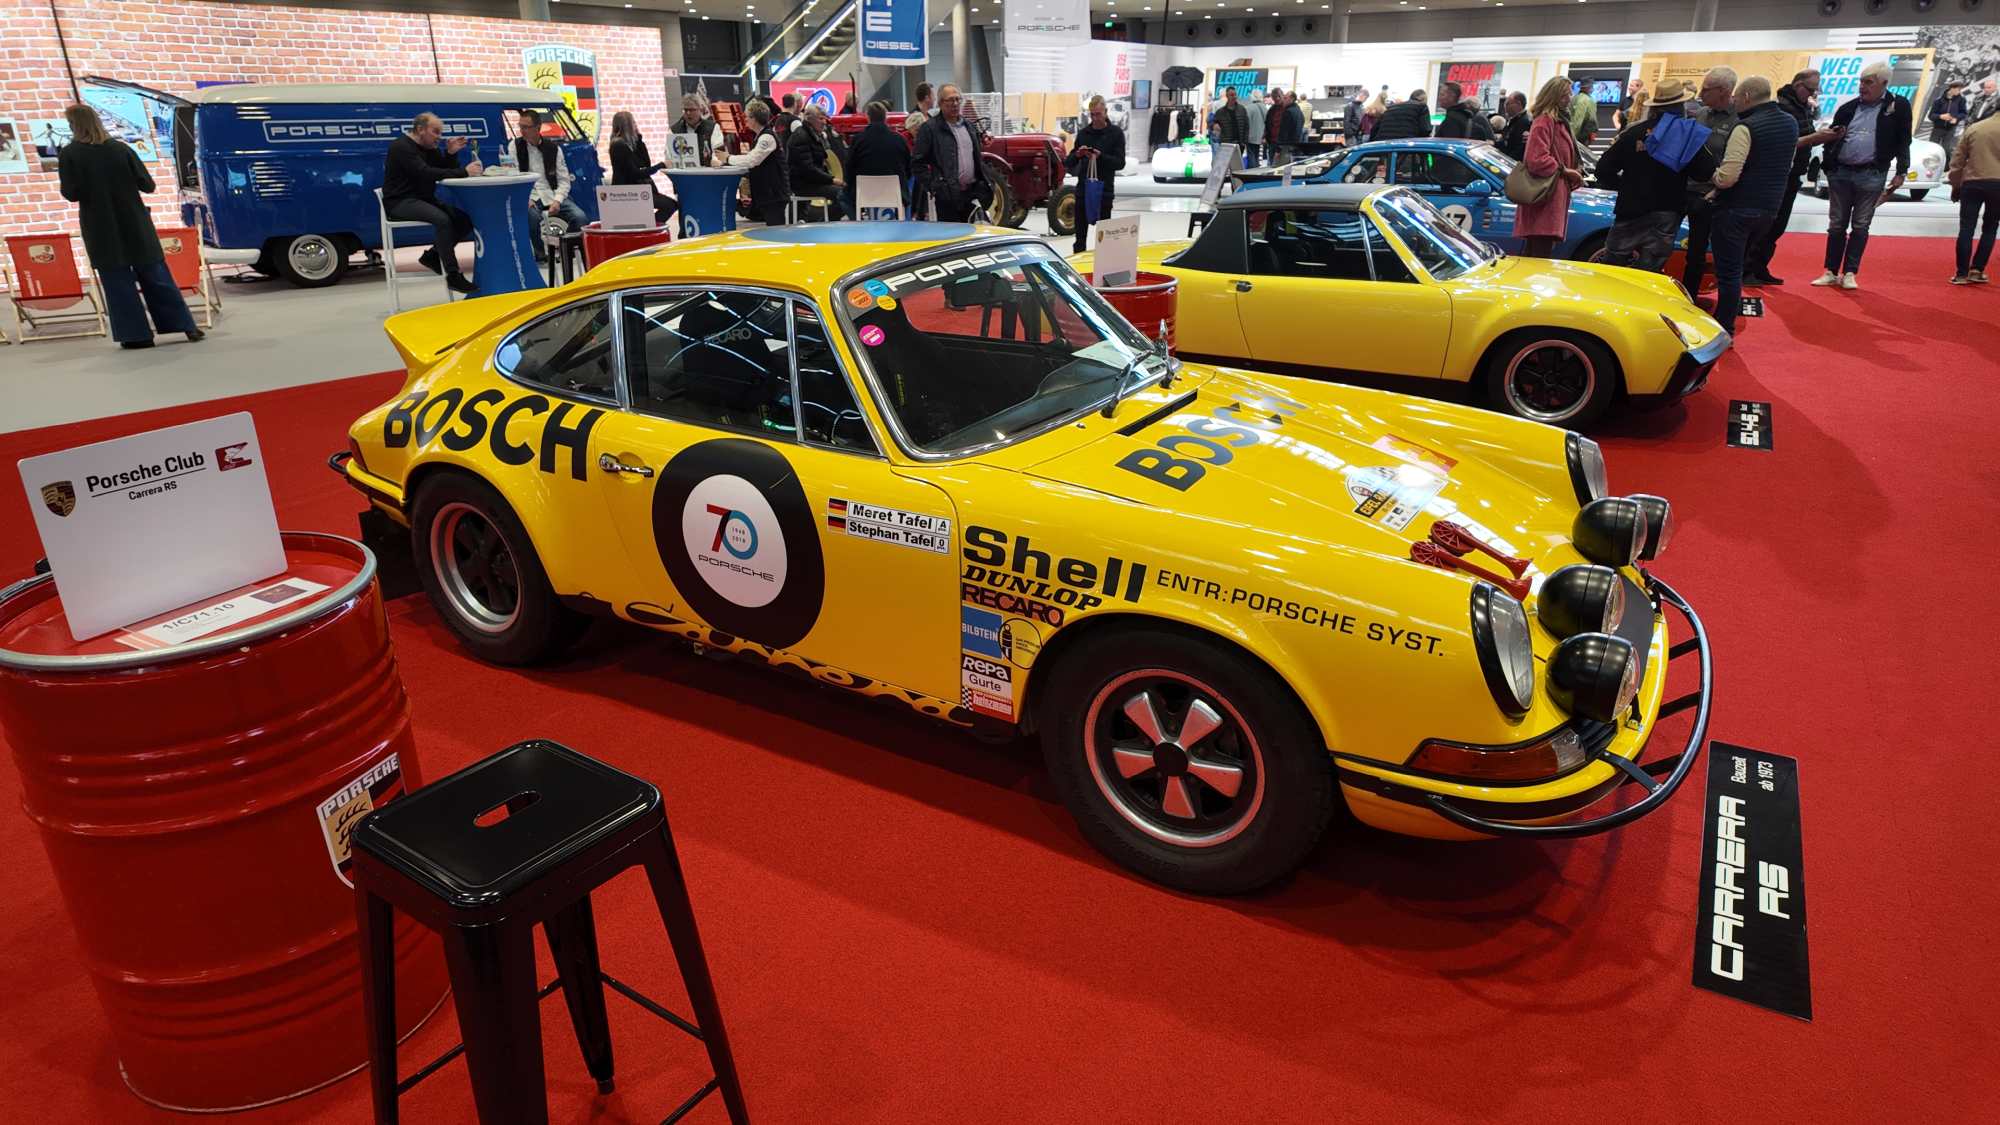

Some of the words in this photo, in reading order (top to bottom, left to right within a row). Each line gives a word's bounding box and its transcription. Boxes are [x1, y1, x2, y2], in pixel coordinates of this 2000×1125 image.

[1017, 24, 1081, 32] PORSCHE
[525, 46, 593, 66] PORSCHE
[866, 40, 920, 50] DIESEL
[1217, 70, 1258, 85] LEICHT
[1821, 56, 1862, 76] WEG
[270, 124, 483, 137] PORSCHE-DSEL
[883, 247, 1048, 292] PORSCHE
[384, 388, 608, 482] BOSCH
[1115, 389, 1308, 492] BOSCH
[86, 464, 162, 492] Porsche
[165, 452, 205, 472] Club
[129, 486, 163, 500] Carrera
[164, 481, 178, 492] RS
[853, 504, 893, 522] Meret
[897, 513, 932, 530] Tafel
[706, 503, 758, 560] 70
[849, 522, 899, 540] Stephan
[903, 532, 934, 548] Tafel
[698, 554, 776, 582] PORSCHE
[963, 525, 1147, 604] Shell
[962, 564, 1103, 610] DUNLOP
[961, 582, 1065, 628] RECARO
[961, 622, 999, 642] BILSTEIN
[1366, 622, 1444, 656] SYST.
[968, 673, 1002, 691] Gurte
[1731, 756, 1747, 784] Bauzeit
[1758, 761, 1774, 779] 1973
[322, 756, 399, 820] PORSCHE
[1759, 780, 1774, 792] ab
[1711, 795, 1746, 982] CARRERA
[1758, 860, 1790, 919] RS
